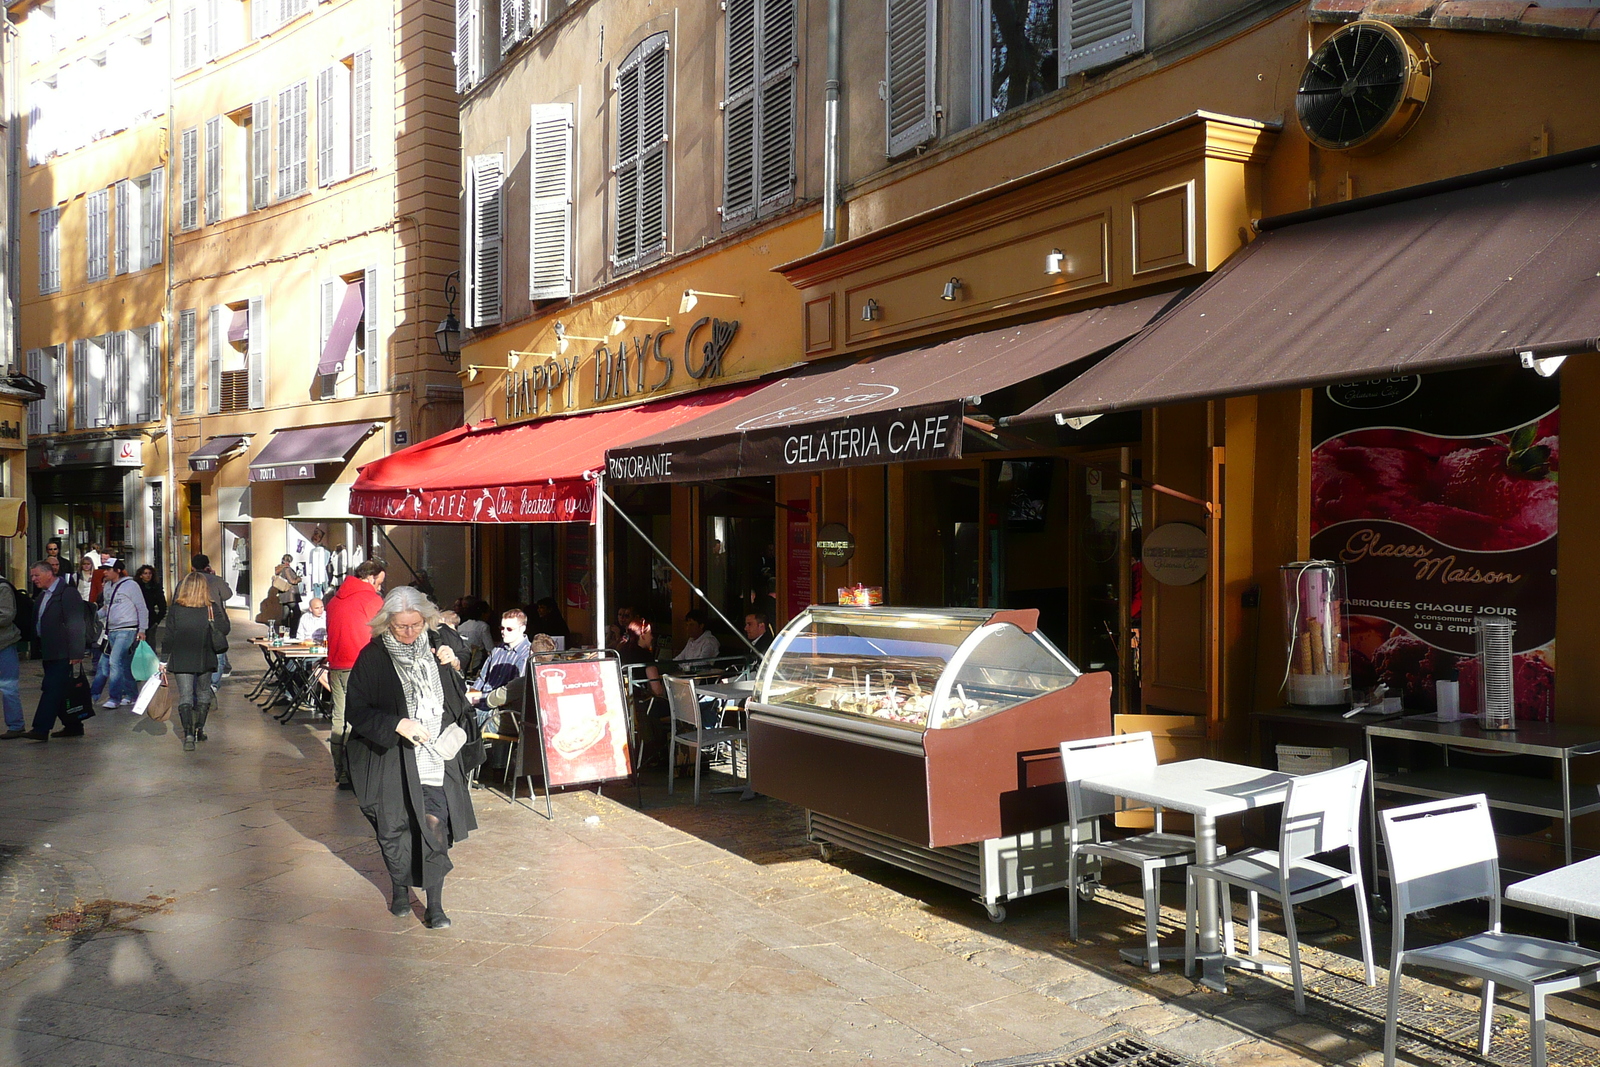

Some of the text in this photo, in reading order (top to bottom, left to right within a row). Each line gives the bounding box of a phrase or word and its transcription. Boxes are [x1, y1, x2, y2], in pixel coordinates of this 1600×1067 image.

[506, 355, 579, 420] HAPPY
[594, 328, 675, 403] DAYS
[784, 415, 949, 465] GELATERIA CAFE
[609, 453, 673, 479] RISTORANTE
[429, 490, 466, 517] CAFÉ
[1339, 528, 1434, 563] Glaces
[1413, 555, 1522, 584] Maison
[1415, 602, 1473, 614] CHAQUE
[1477, 606, 1518, 616] JOUR
[1421, 614, 1472, 623] consommer
[1414, 622, 1432, 630] ou
